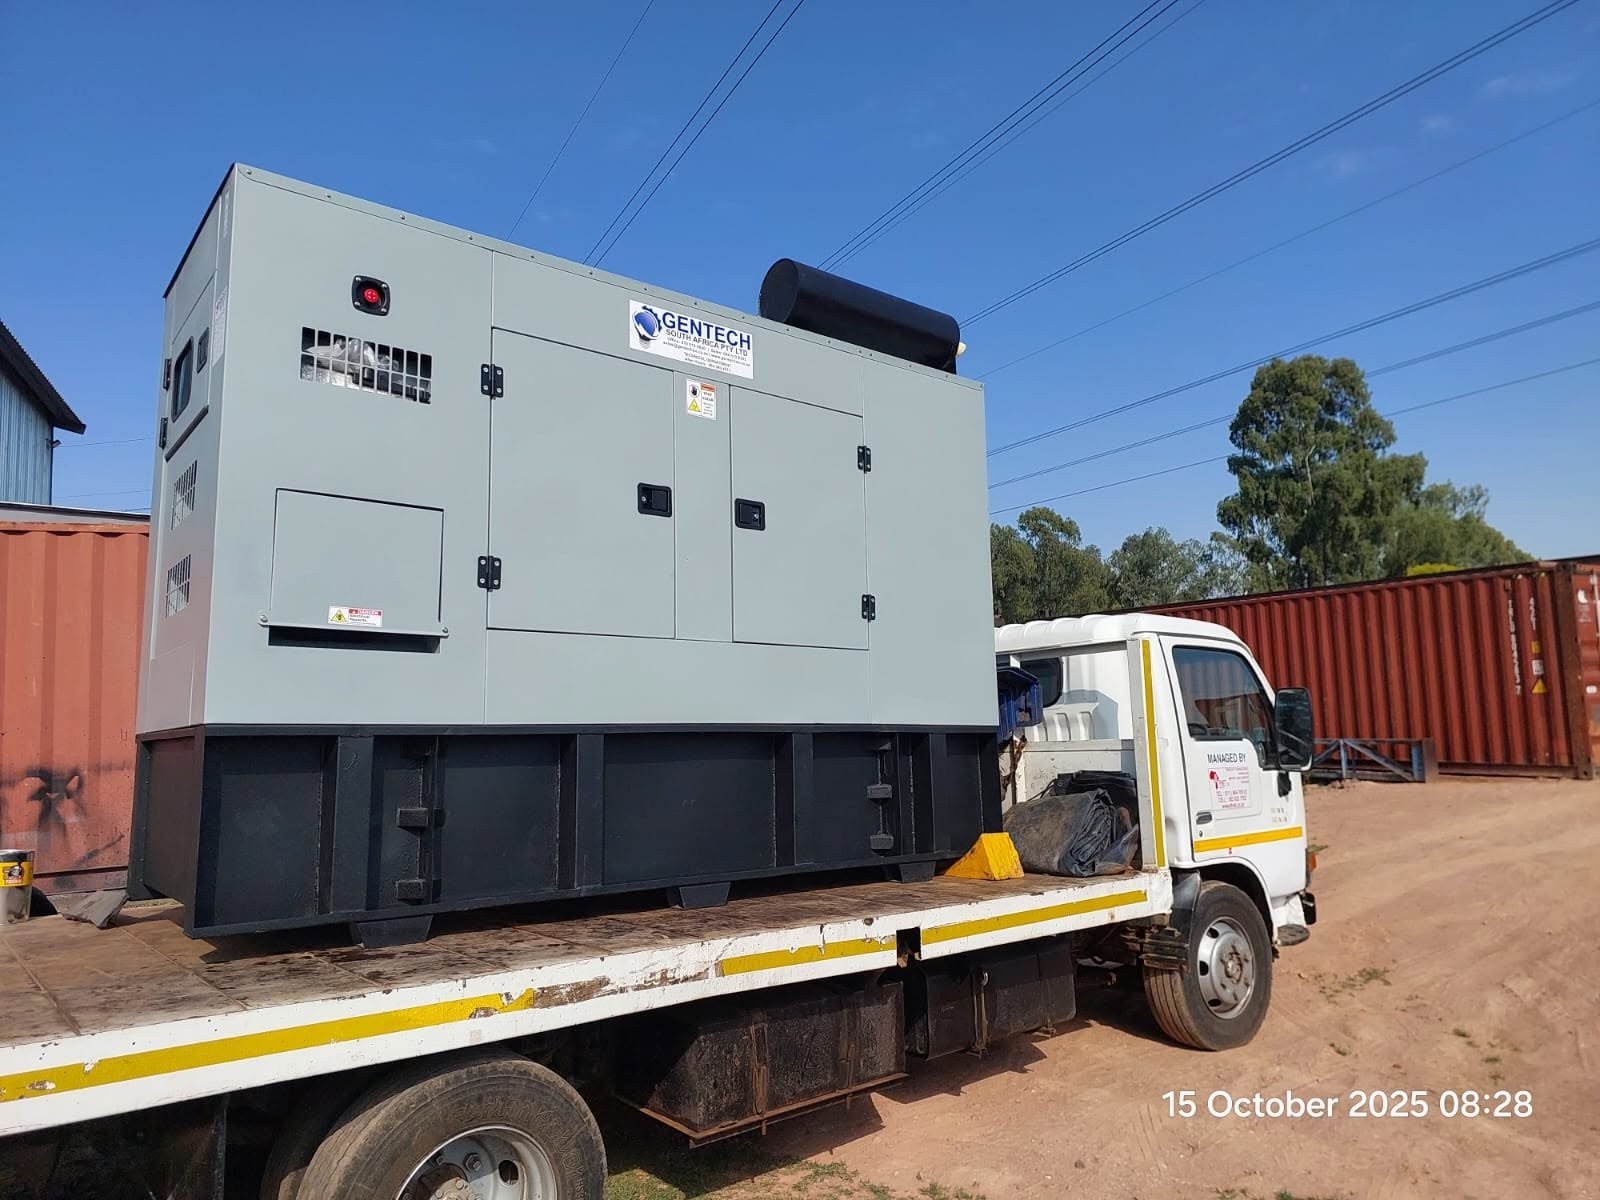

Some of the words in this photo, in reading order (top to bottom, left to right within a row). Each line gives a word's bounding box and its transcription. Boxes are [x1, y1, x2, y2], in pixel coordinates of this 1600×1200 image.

[662, 312, 751, 350] GENTECH
[665, 329, 691, 341] SOUTH
[693, 336, 719, 350] AFRICA
[721, 344, 734, 353] PTY
[735, 347, 748, 357] LTD
[1207, 753, 1238, 764] MANAGED
[1239, 753, 1247, 762] BY
